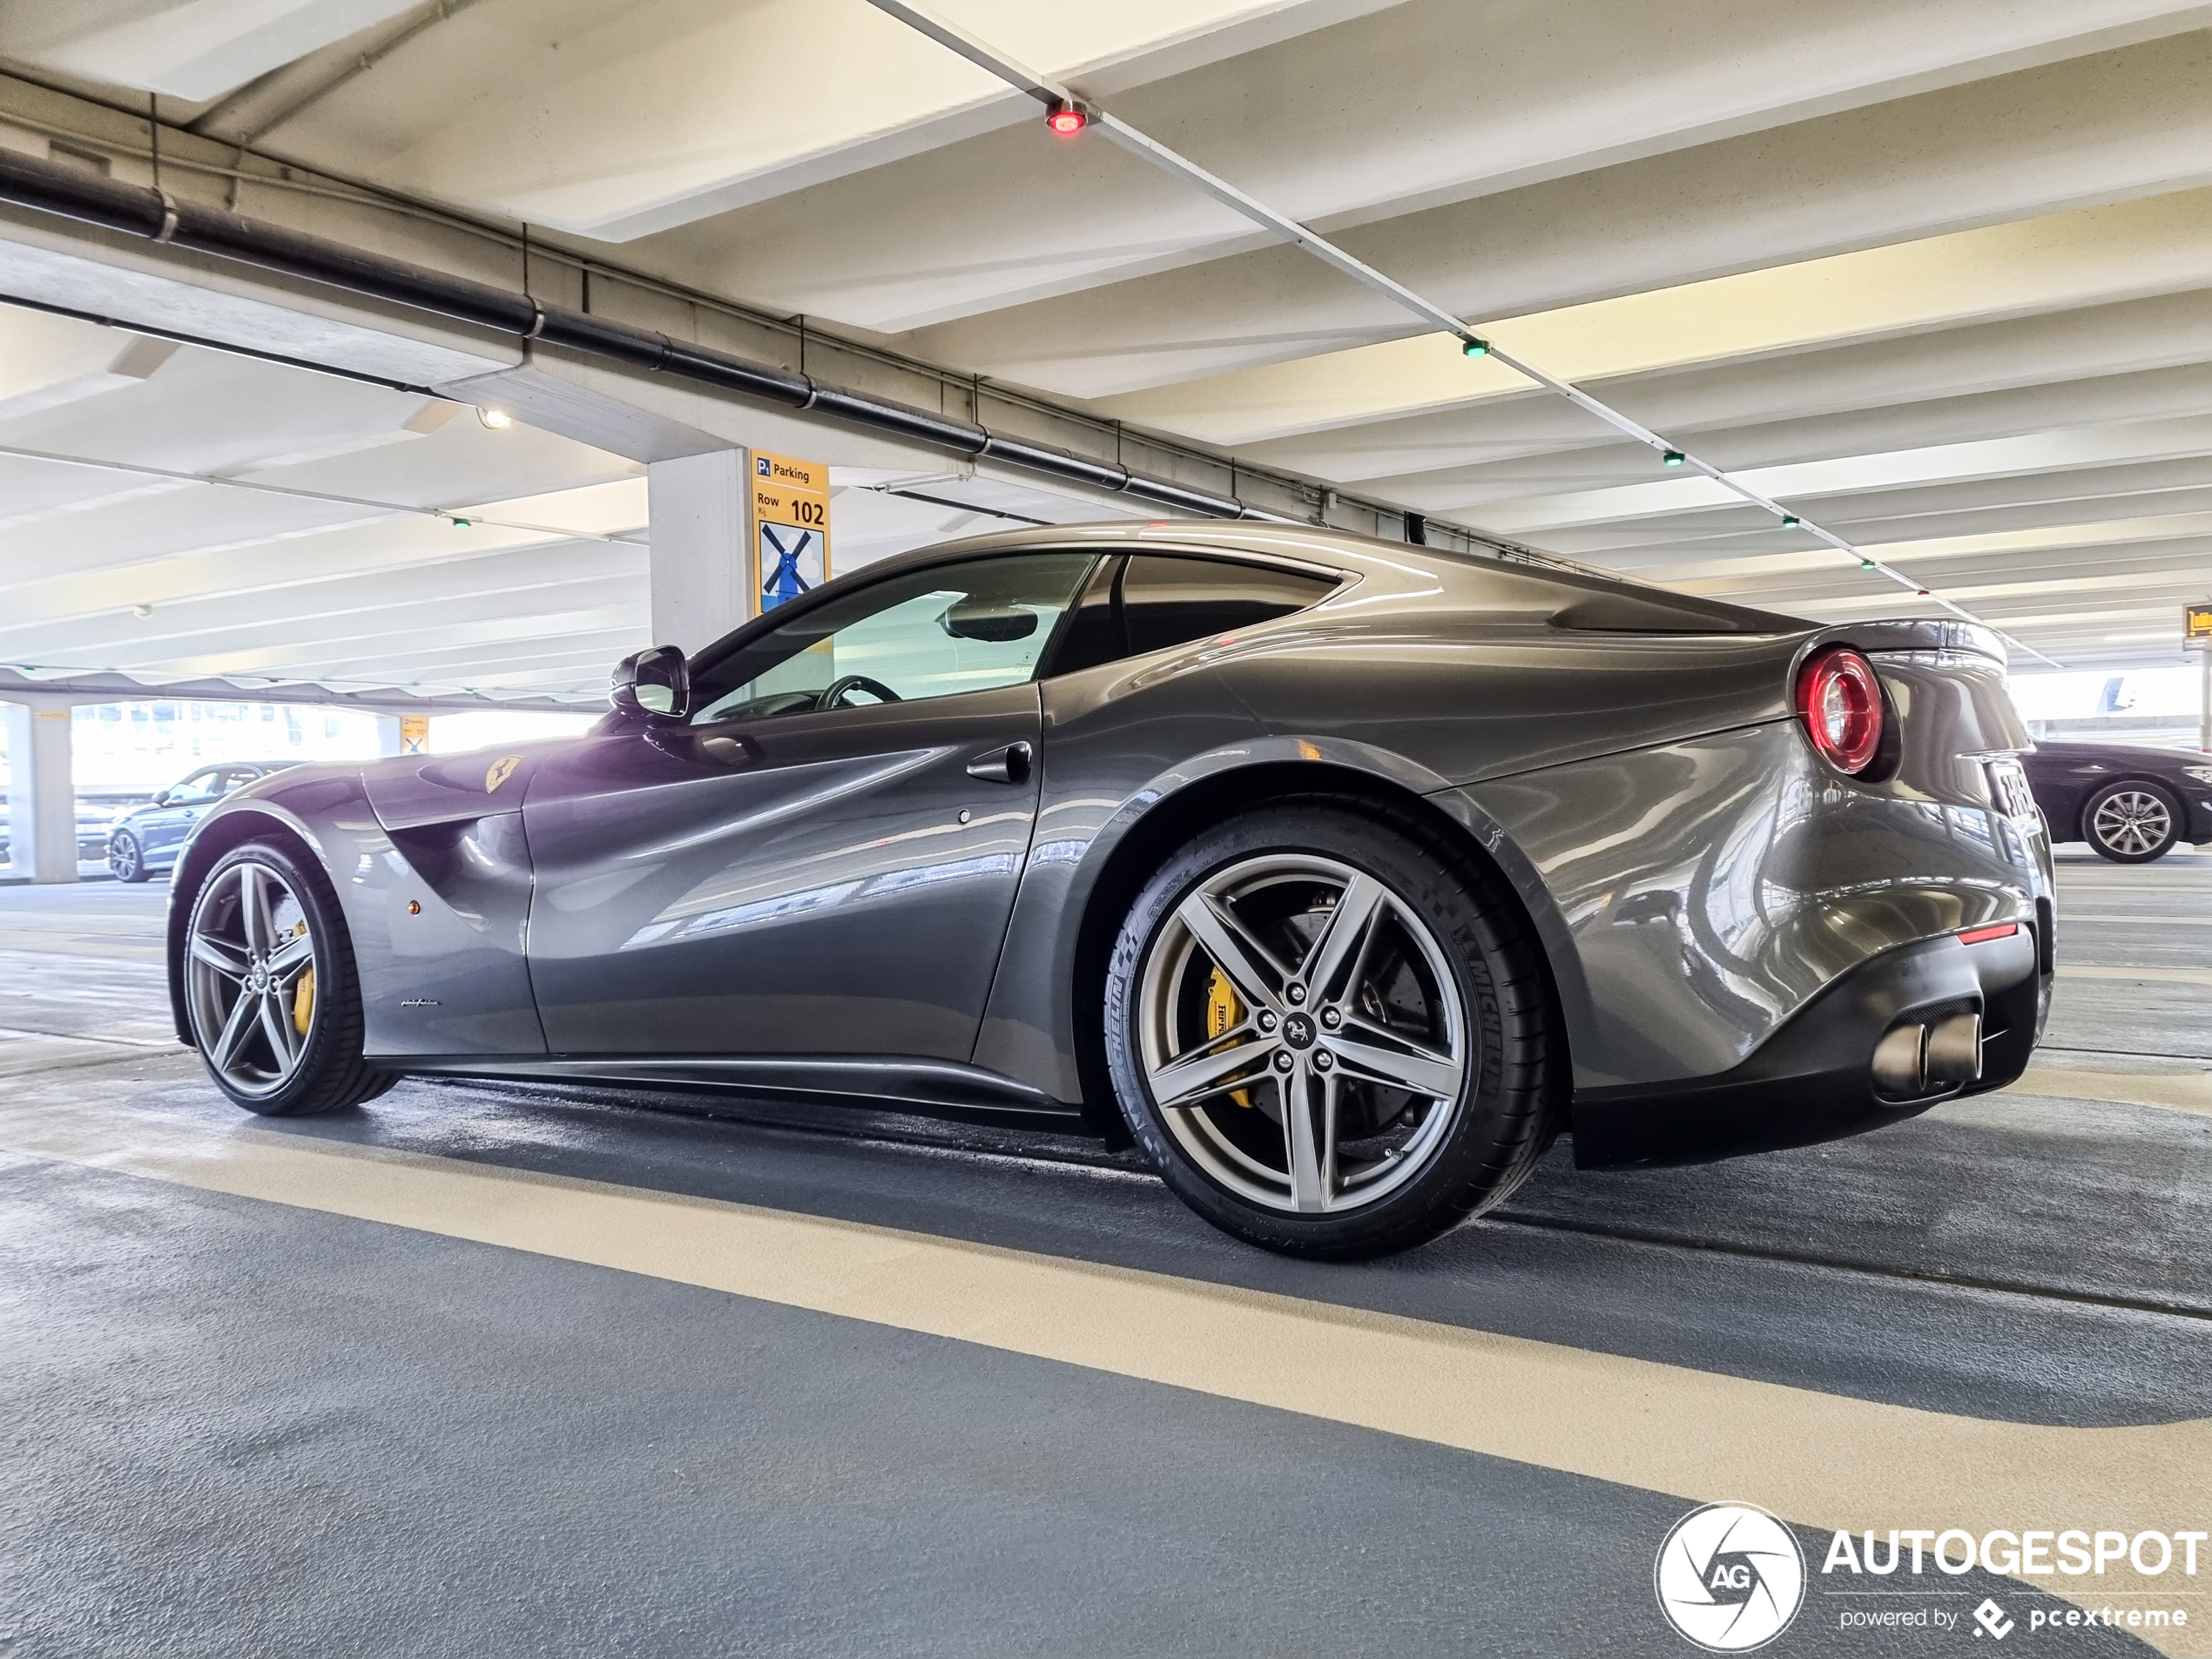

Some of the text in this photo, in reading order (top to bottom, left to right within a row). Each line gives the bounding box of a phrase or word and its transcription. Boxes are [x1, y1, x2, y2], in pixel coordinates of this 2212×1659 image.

[758, 493, 824, 525] Row 102
[774, 464, 809, 483] Parking
[1111, 976, 1132, 1096] MICHELIN
[1469, 960, 1502, 1096] MICHELIN
